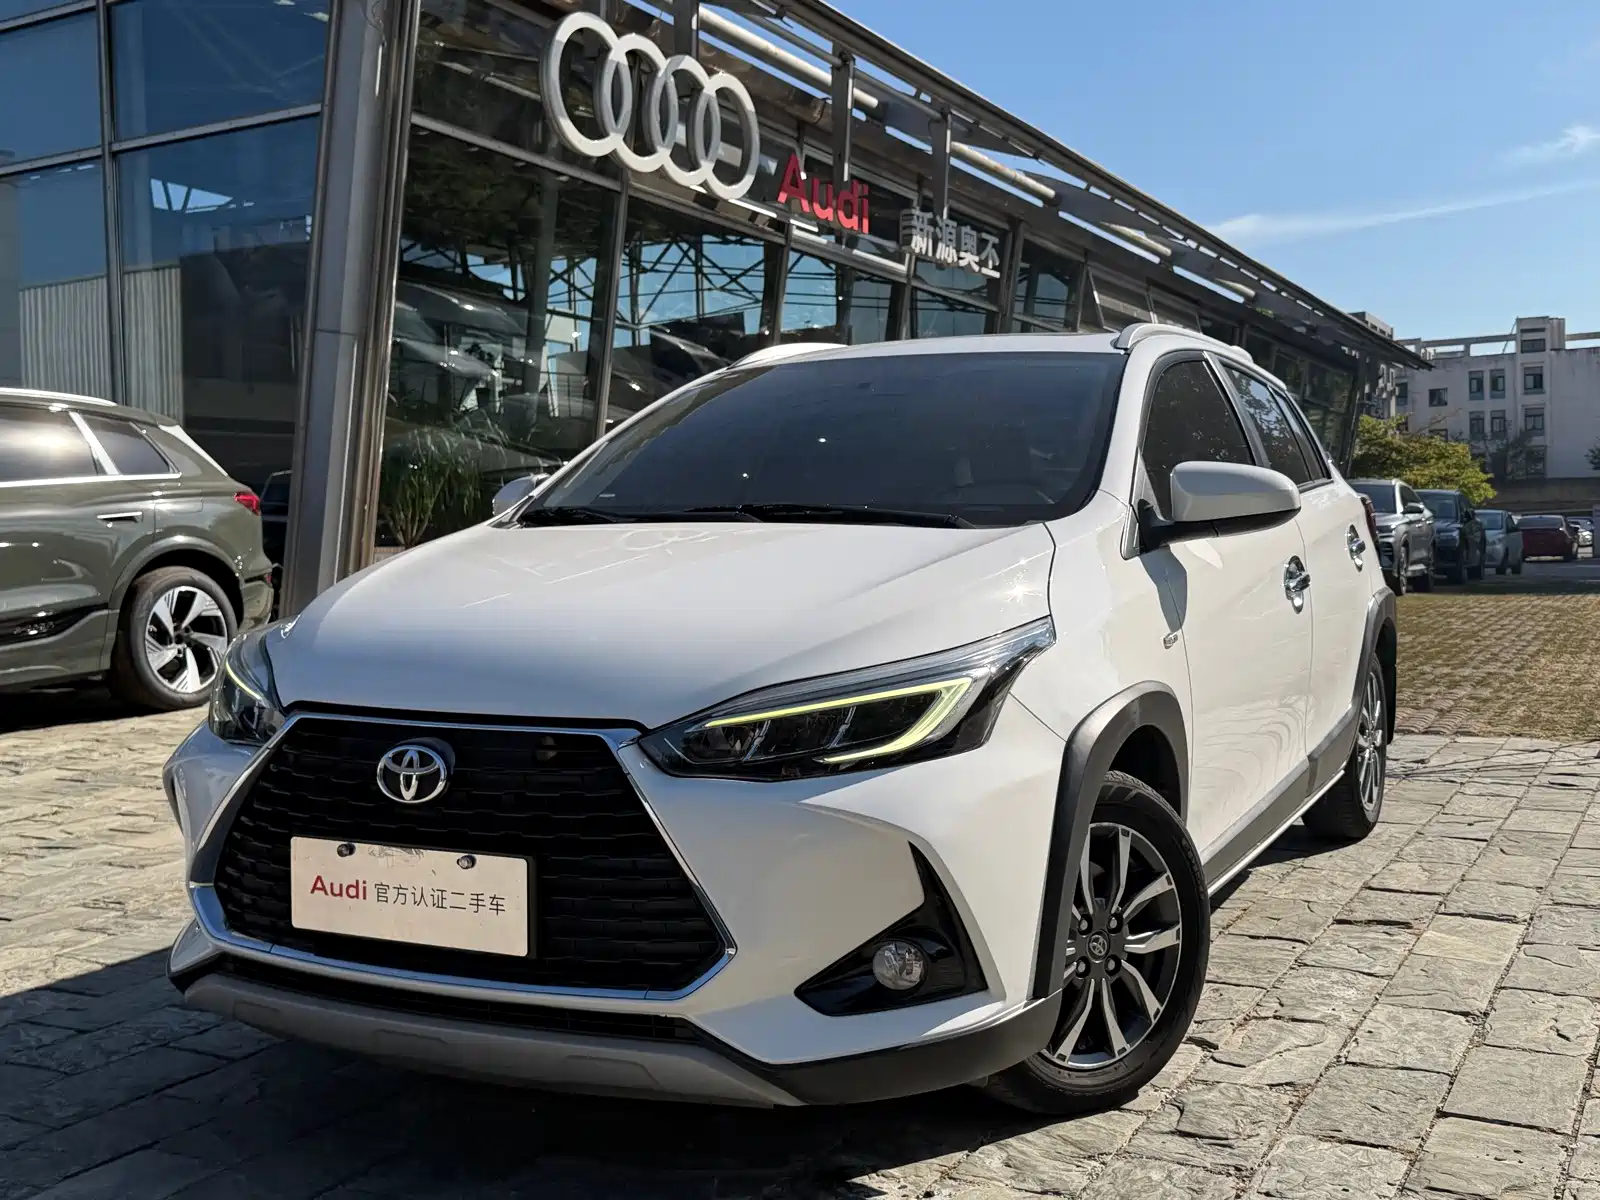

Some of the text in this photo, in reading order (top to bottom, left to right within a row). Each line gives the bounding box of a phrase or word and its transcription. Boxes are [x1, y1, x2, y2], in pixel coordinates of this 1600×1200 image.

[777, 152, 869, 235] Audi
[310, 875, 506, 916] Audi 官方认证二手车
